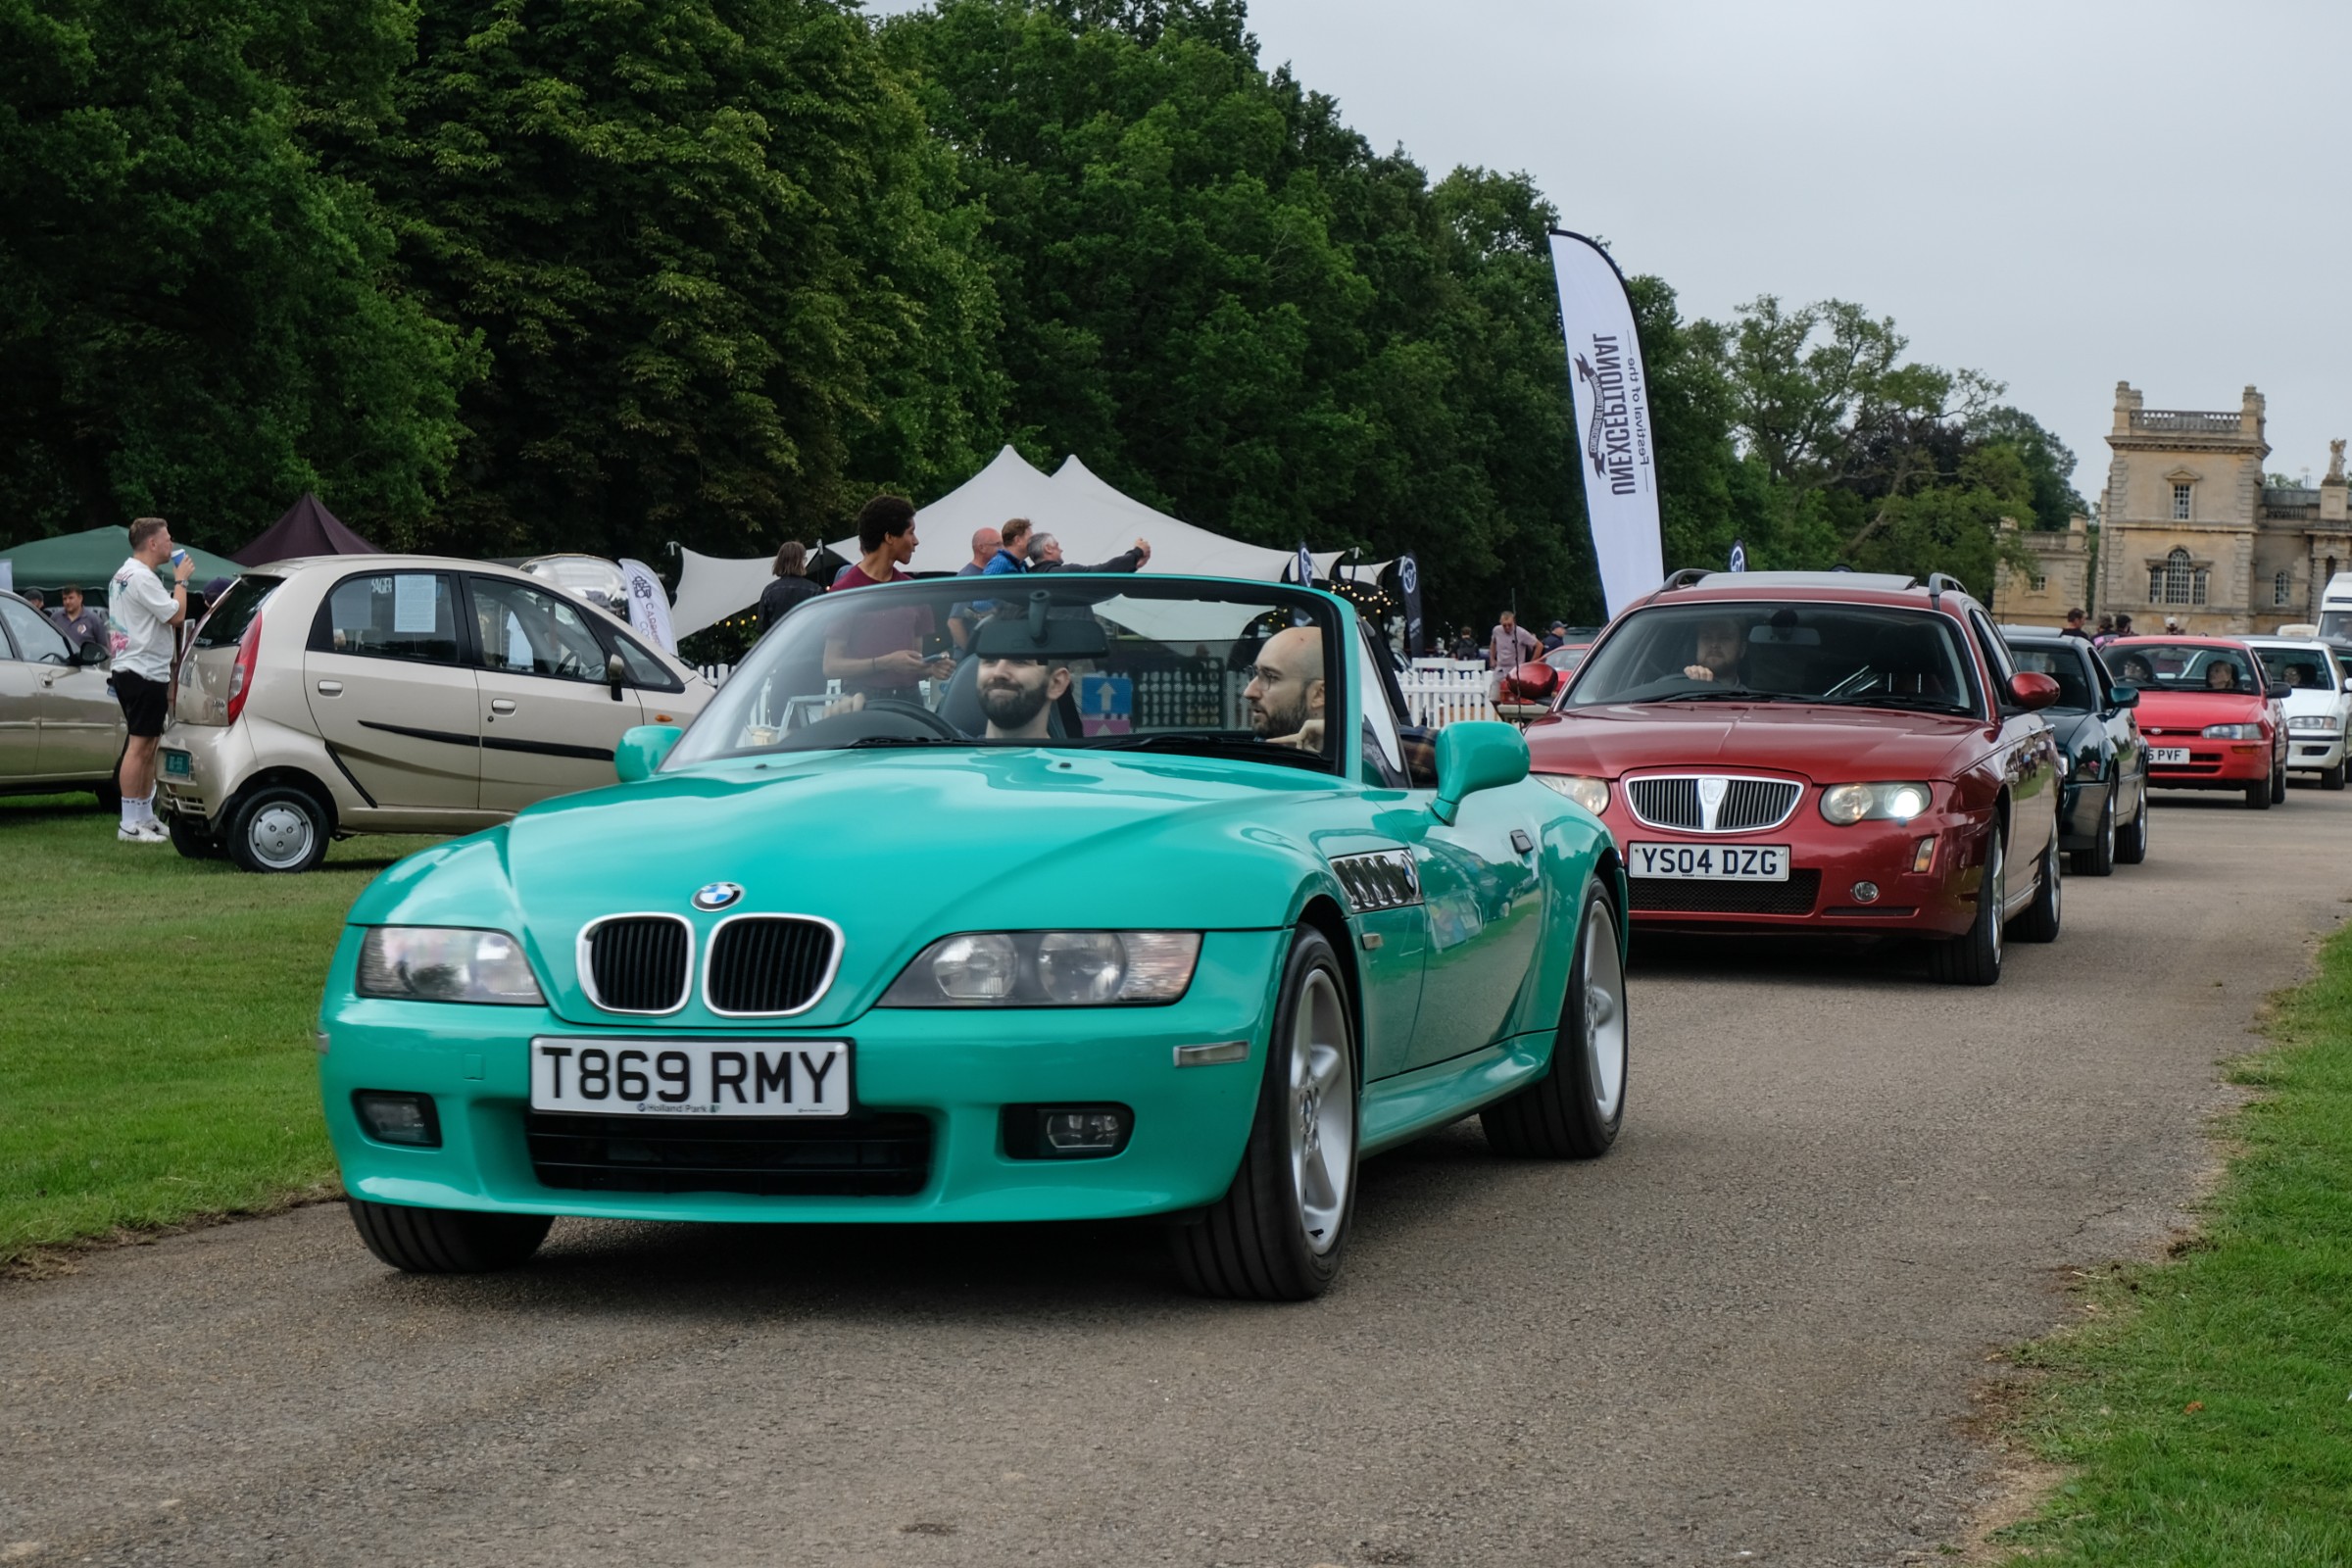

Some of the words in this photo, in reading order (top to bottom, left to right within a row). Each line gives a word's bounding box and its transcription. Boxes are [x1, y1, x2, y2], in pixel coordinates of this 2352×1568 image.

[2158, 749, 2181, 760] PVF
[1642, 847, 1713, 874] YS04
[1722, 849, 1777, 875] DZG
[541, 1046, 690, 1103] T869
[710, 1052, 837, 1103] RMY
[646, 1104, 682, 1113] Holland
[685, 1104, 708, 1113] Park
